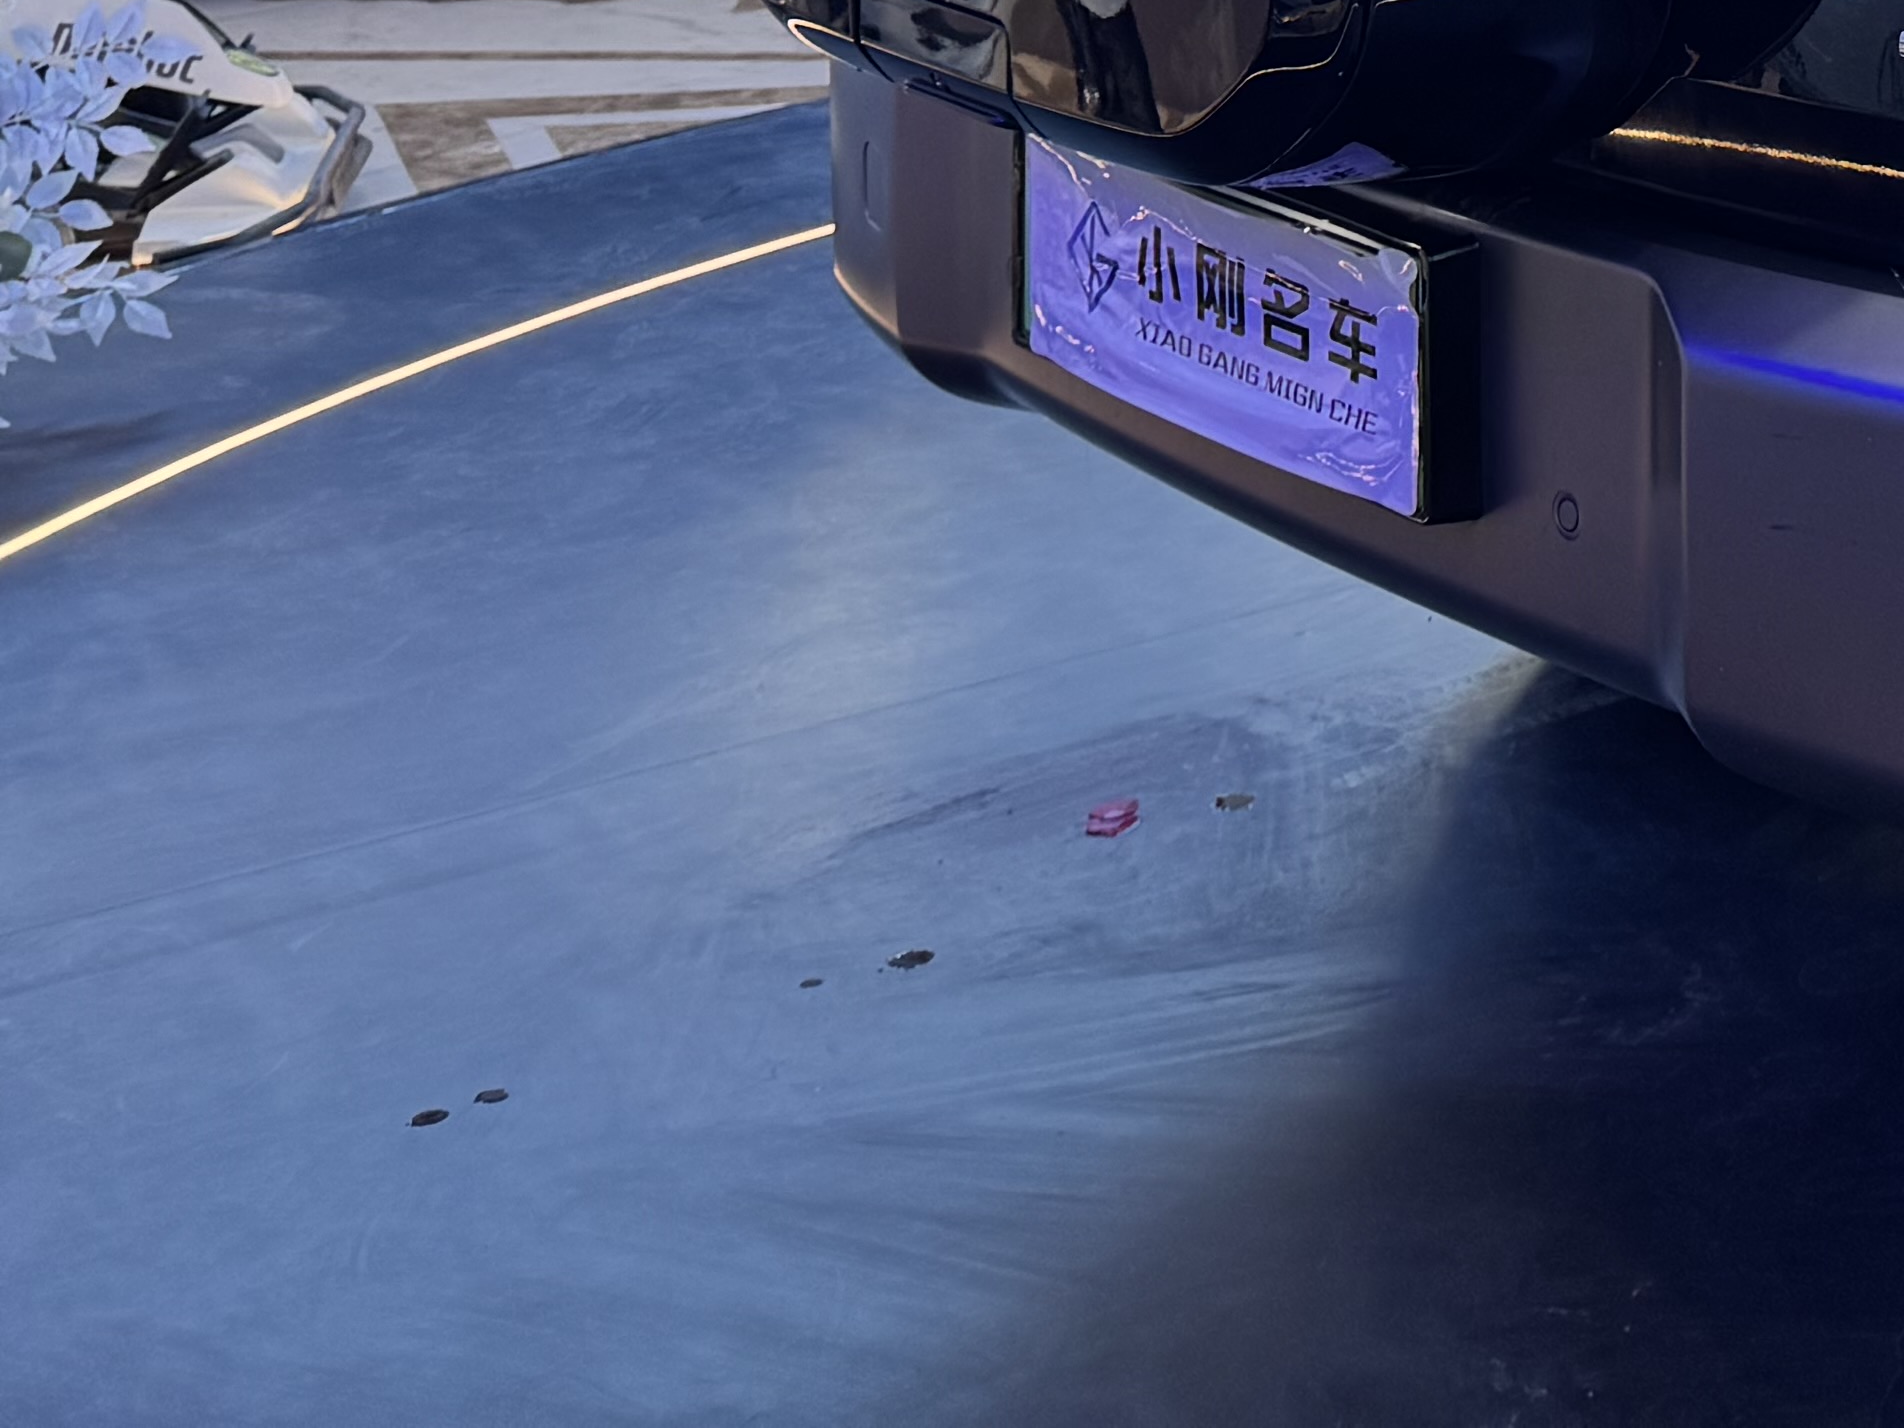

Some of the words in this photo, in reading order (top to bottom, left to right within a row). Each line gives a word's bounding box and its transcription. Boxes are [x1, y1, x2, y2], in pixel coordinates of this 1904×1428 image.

[1136, 225, 1379, 384] 小刚名车
[1135, 316, 1193, 361] XIAO
[1197, 343, 1260, 388] GANG
[1265, 369, 1324, 415] MIGN
[1328, 396, 1379, 436] CHE
